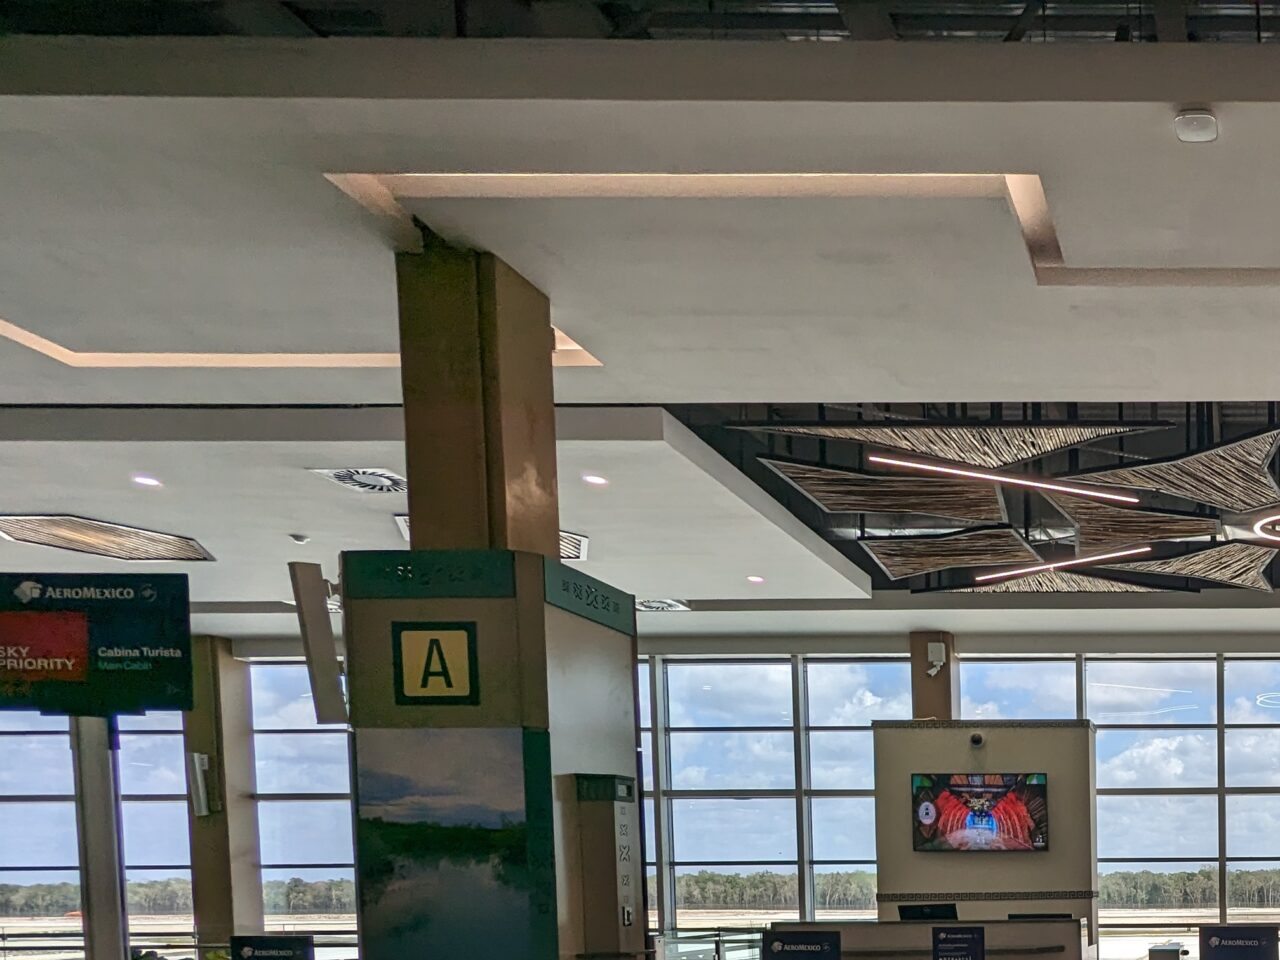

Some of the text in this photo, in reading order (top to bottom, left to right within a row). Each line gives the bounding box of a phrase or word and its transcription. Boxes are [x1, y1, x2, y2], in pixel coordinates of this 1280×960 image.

[97, 646, 183, 658] Cabina Turista
[420, 637, 454, 689] A
